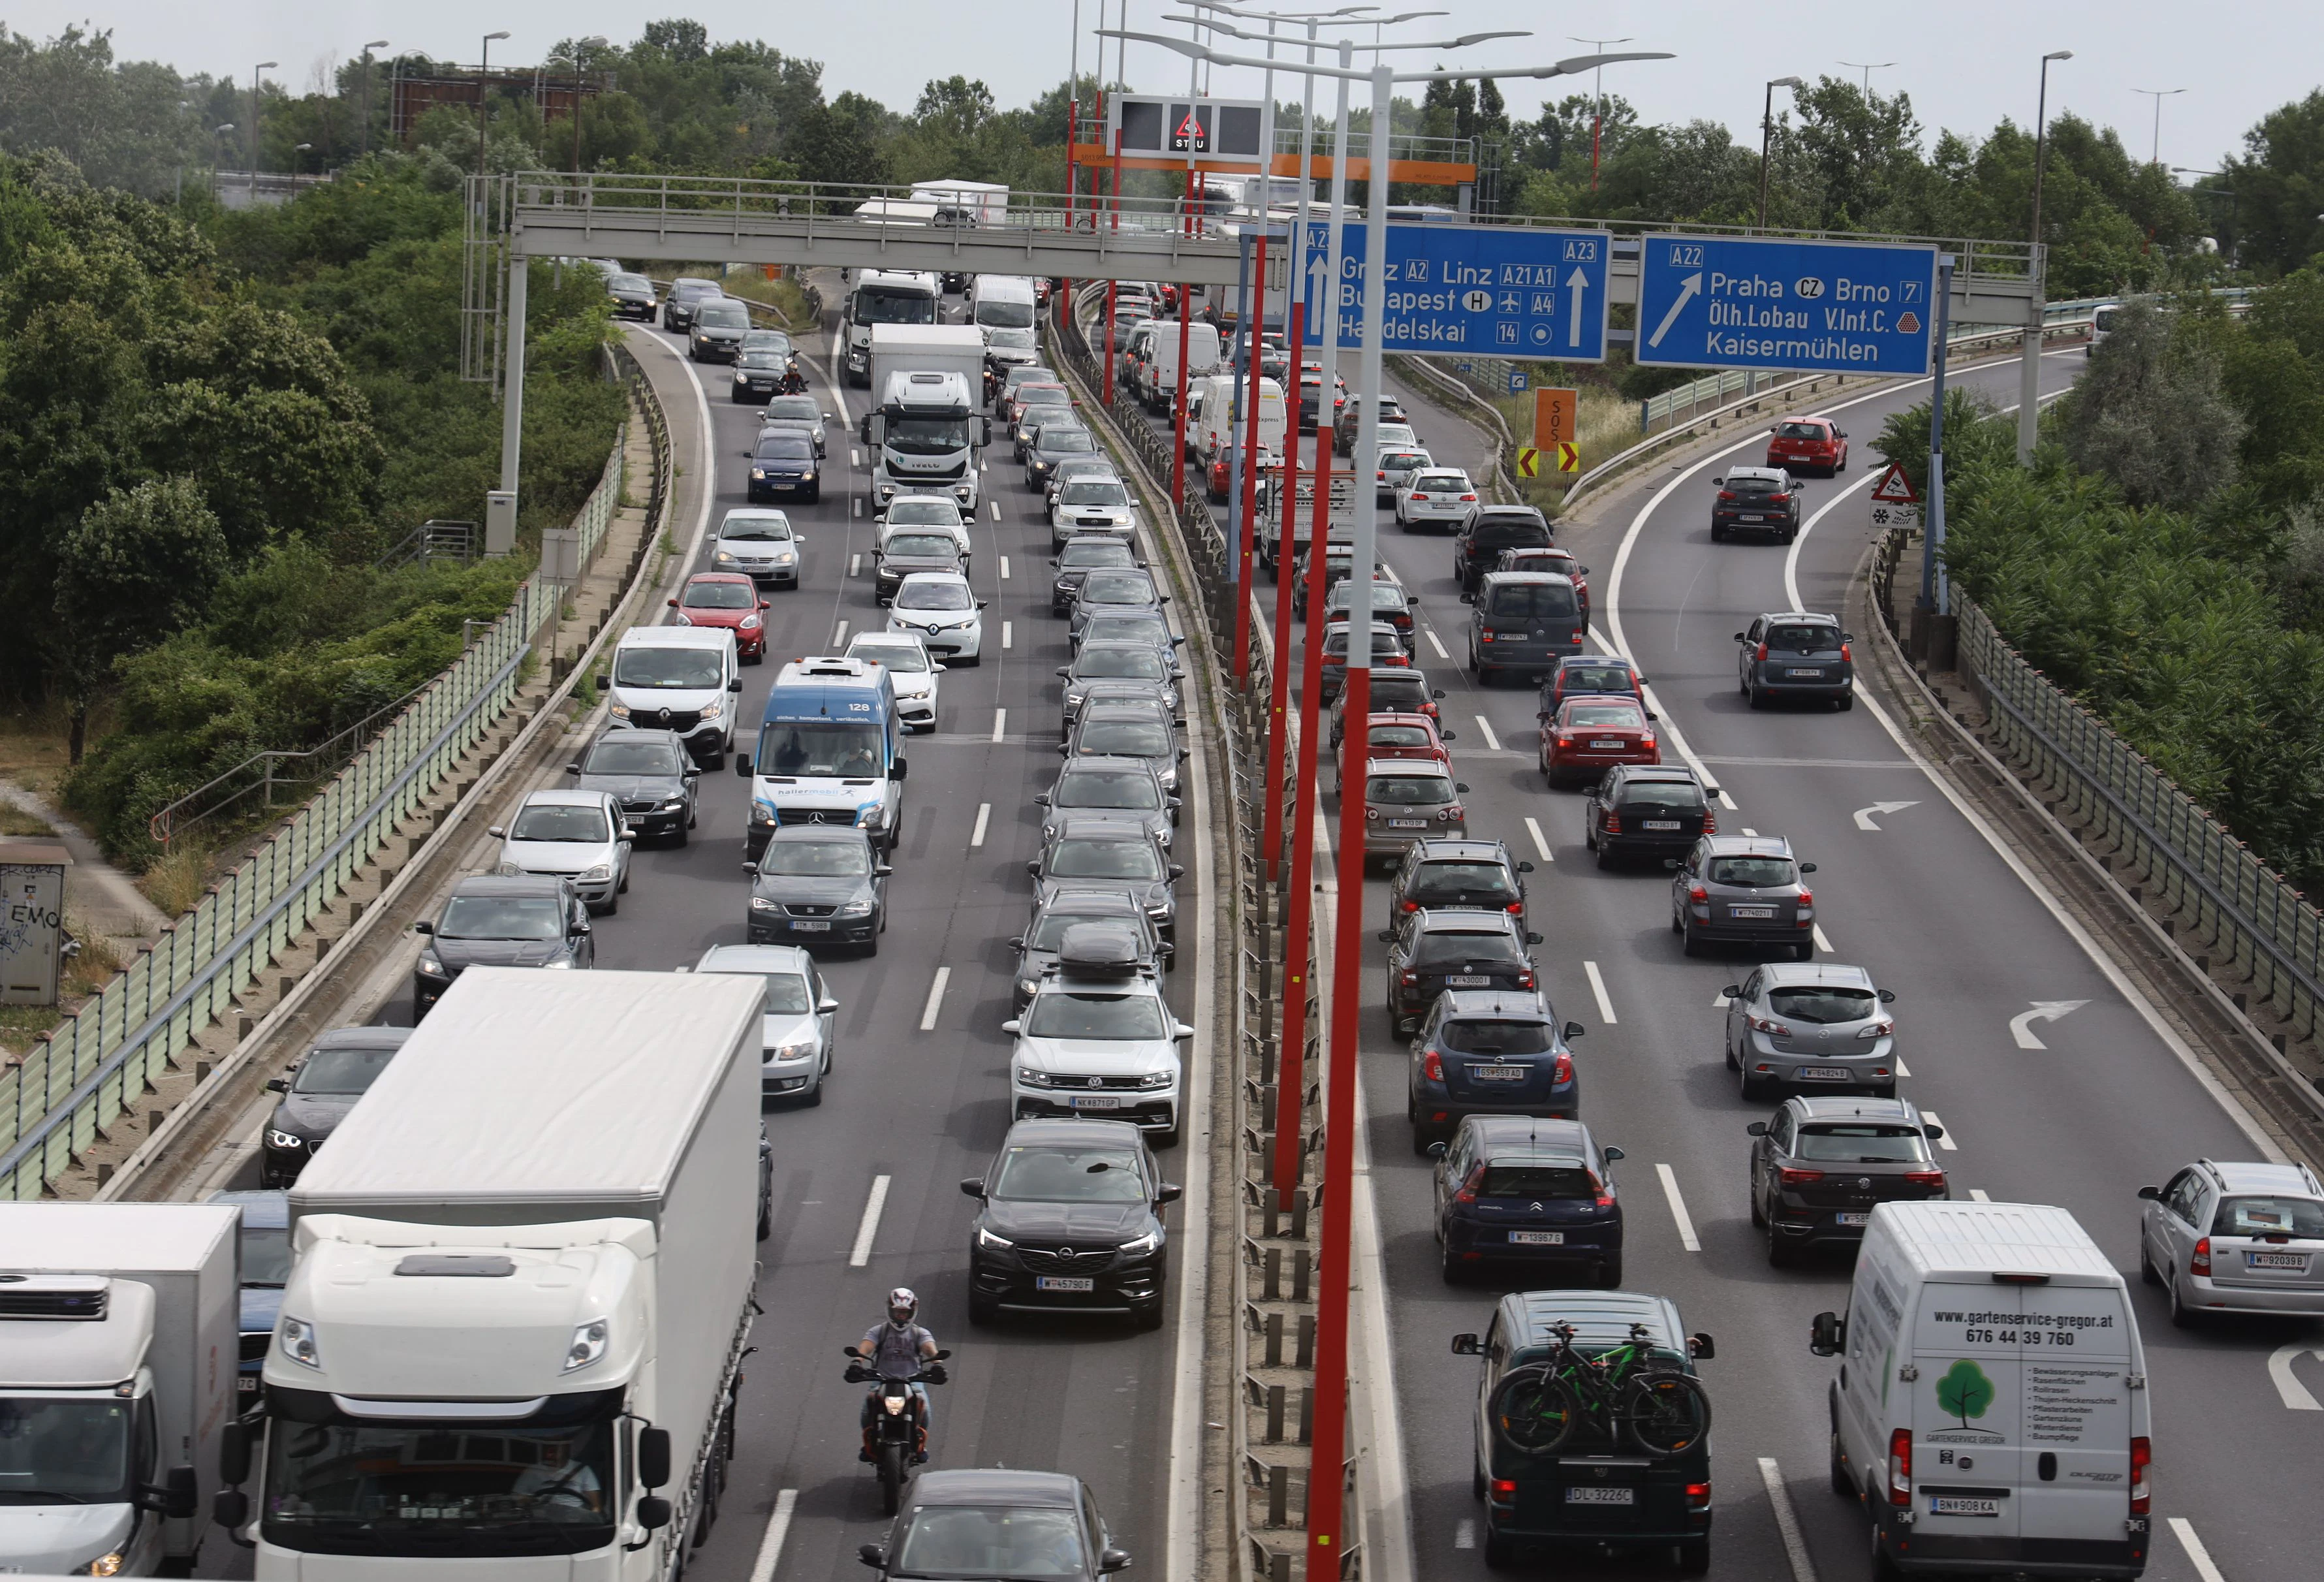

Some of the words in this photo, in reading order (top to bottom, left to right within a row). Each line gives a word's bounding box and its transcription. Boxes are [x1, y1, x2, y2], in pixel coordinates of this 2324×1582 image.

[1176, 138, 1204, 149] STU
[1306, 230, 1329, 248] A2
[1565, 242, 1595, 261] A23
[1671, 246, 1702, 266] A22
[1342, 255, 1399, 281] Grz
[1407, 262, 1427, 280] A2
[1443, 261, 1493, 285] Linz
[1502, 266, 1531, 285] A21
[1534, 268, 1552, 286] A1
[1710, 271, 1783, 298] Praha
[1800, 279, 1819, 298] CZ
[1836, 277, 1890, 304] Brno
[1906, 283, 1917, 302] 7
[1340, 283, 1456, 315] Buapest
[1471, 293, 1483, 310] H
[1532, 294, 1552, 313] A4
[1709, 298, 1809, 330] Ölh.Lobau
[1338, 314, 1466, 342] Hadelskai
[1500, 324, 1516, 342] 14
[1706, 330, 1878, 362] Kaisermühlen
[1550, 400, 1561, 442] SOS
[12, 905, 60, 929] EMO
[1934, 1310, 2114, 1330] www.gartenservice-gregor.at
[1966, 1329, 1993, 1343] 676
[1999, 1330, 2017, 1344] 44
[2023, 1331, 2041, 1345] 39
[2047, 1332, 2074, 1346] 760
[2032, 1385, 2071, 1394] Rollrasen
[2033, 1376, 2086, 1385] Rasenflächen
[2033, 1423, 2083, 1432] Winterdienst
[1926, 1434, 1978, 1444] GARTENSERVICE
[1979, 1436, 2006, 1444] GREGOR
[2032, 1433, 2079, 1442] Baumpflege
[1573, 1488, 1590, 1500] DL
